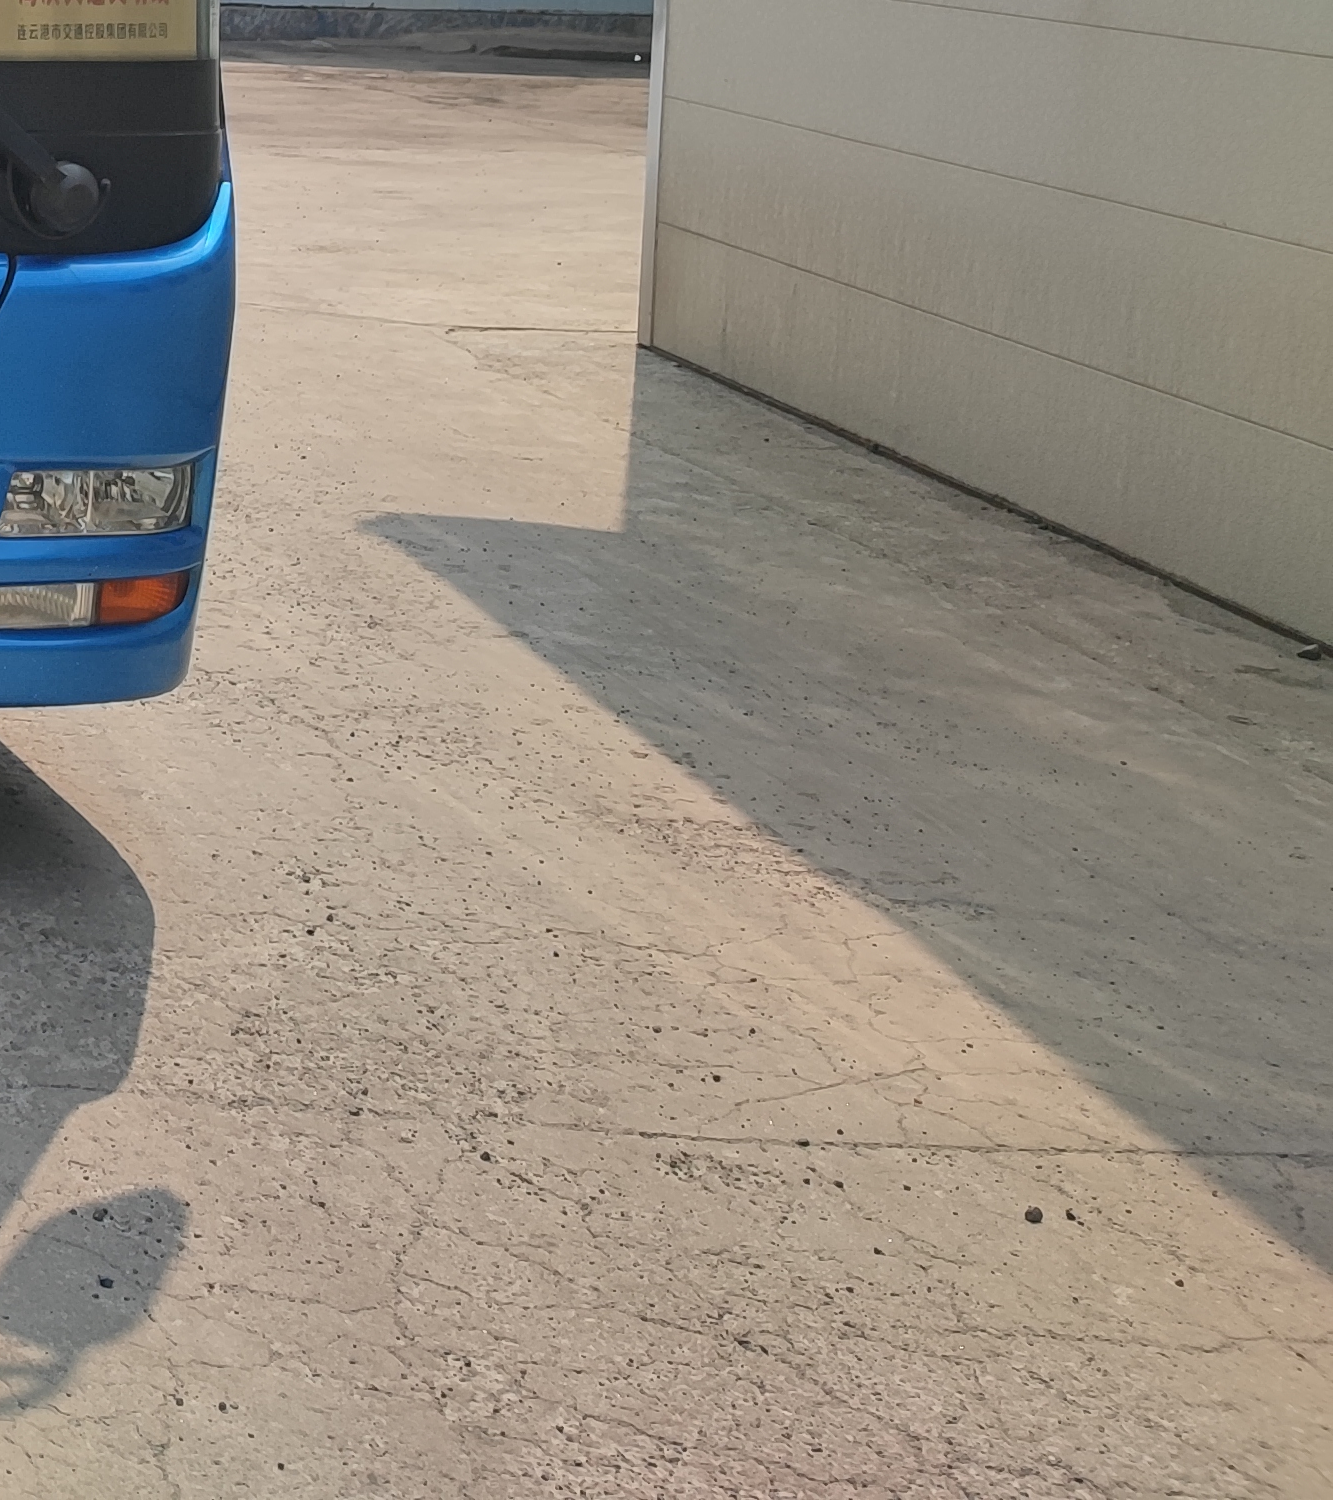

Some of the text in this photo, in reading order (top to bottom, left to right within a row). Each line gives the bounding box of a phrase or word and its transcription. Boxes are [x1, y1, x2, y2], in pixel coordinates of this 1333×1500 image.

[17, 21, 169, 42] 连云港市交通控股集团有限公司
